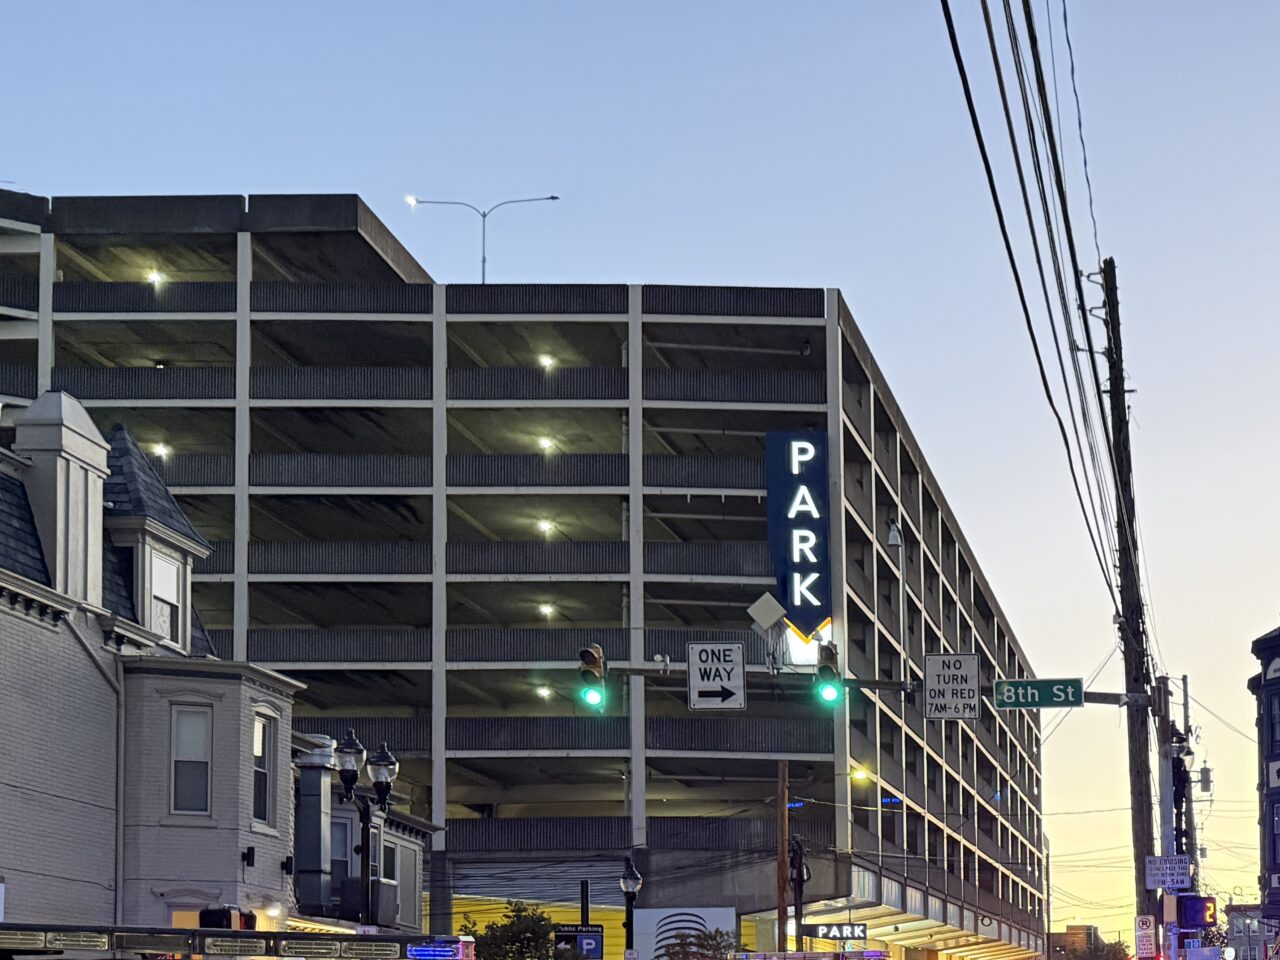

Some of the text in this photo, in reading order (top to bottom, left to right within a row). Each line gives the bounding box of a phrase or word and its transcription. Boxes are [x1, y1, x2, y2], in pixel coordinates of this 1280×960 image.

[788, 441, 822, 606] PARK
[698, 648, 734, 664] ONE
[942, 659, 962, 670] NO
[698, 666, 735, 682] WAY
[935, 674, 968, 685] TURN
[929, 688, 975, 699] ON RED
[1003, 685, 1075, 703] 8th St
[818, 925, 865, 938] PARK
